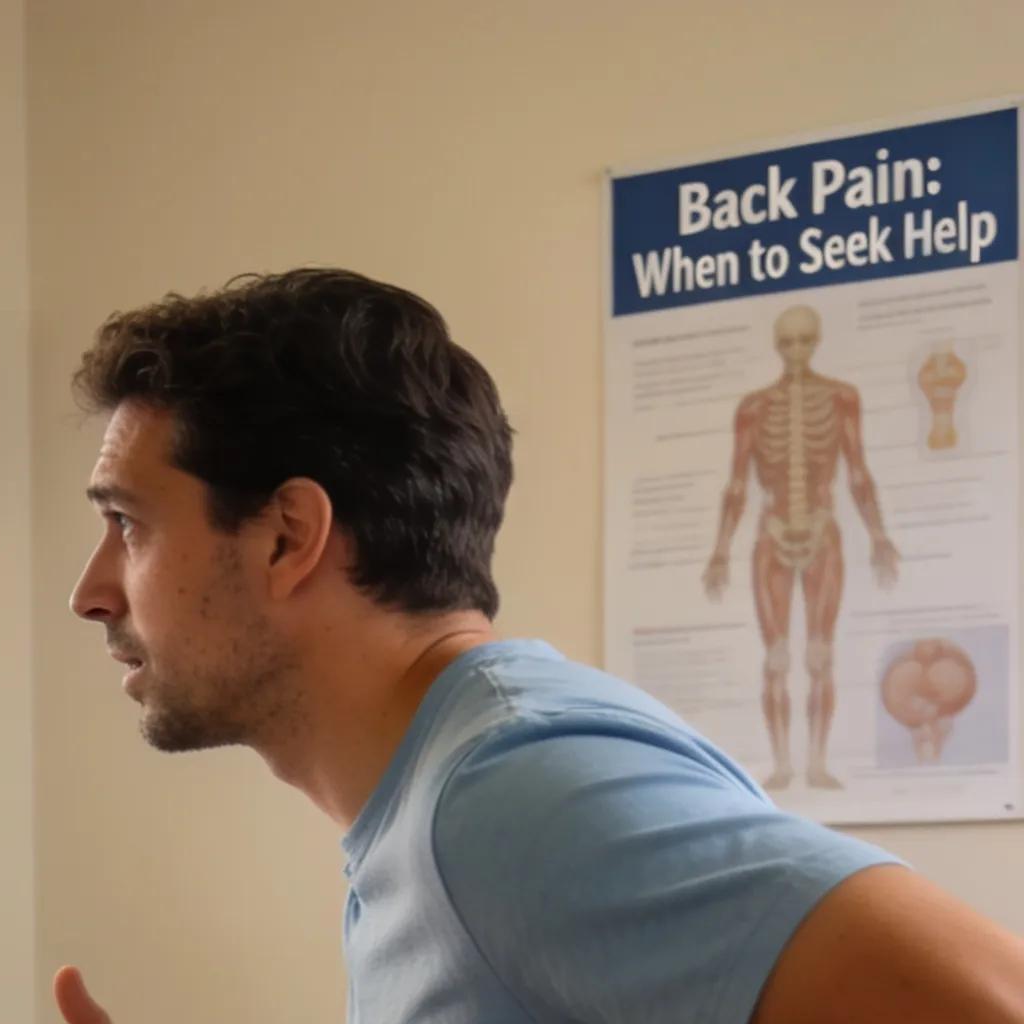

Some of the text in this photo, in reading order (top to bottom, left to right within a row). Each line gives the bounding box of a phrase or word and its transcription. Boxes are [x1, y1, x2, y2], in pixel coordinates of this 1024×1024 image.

[679, 148, 942, 235] Back Pain:
[632, 200, 997, 298] When to Seek Help
